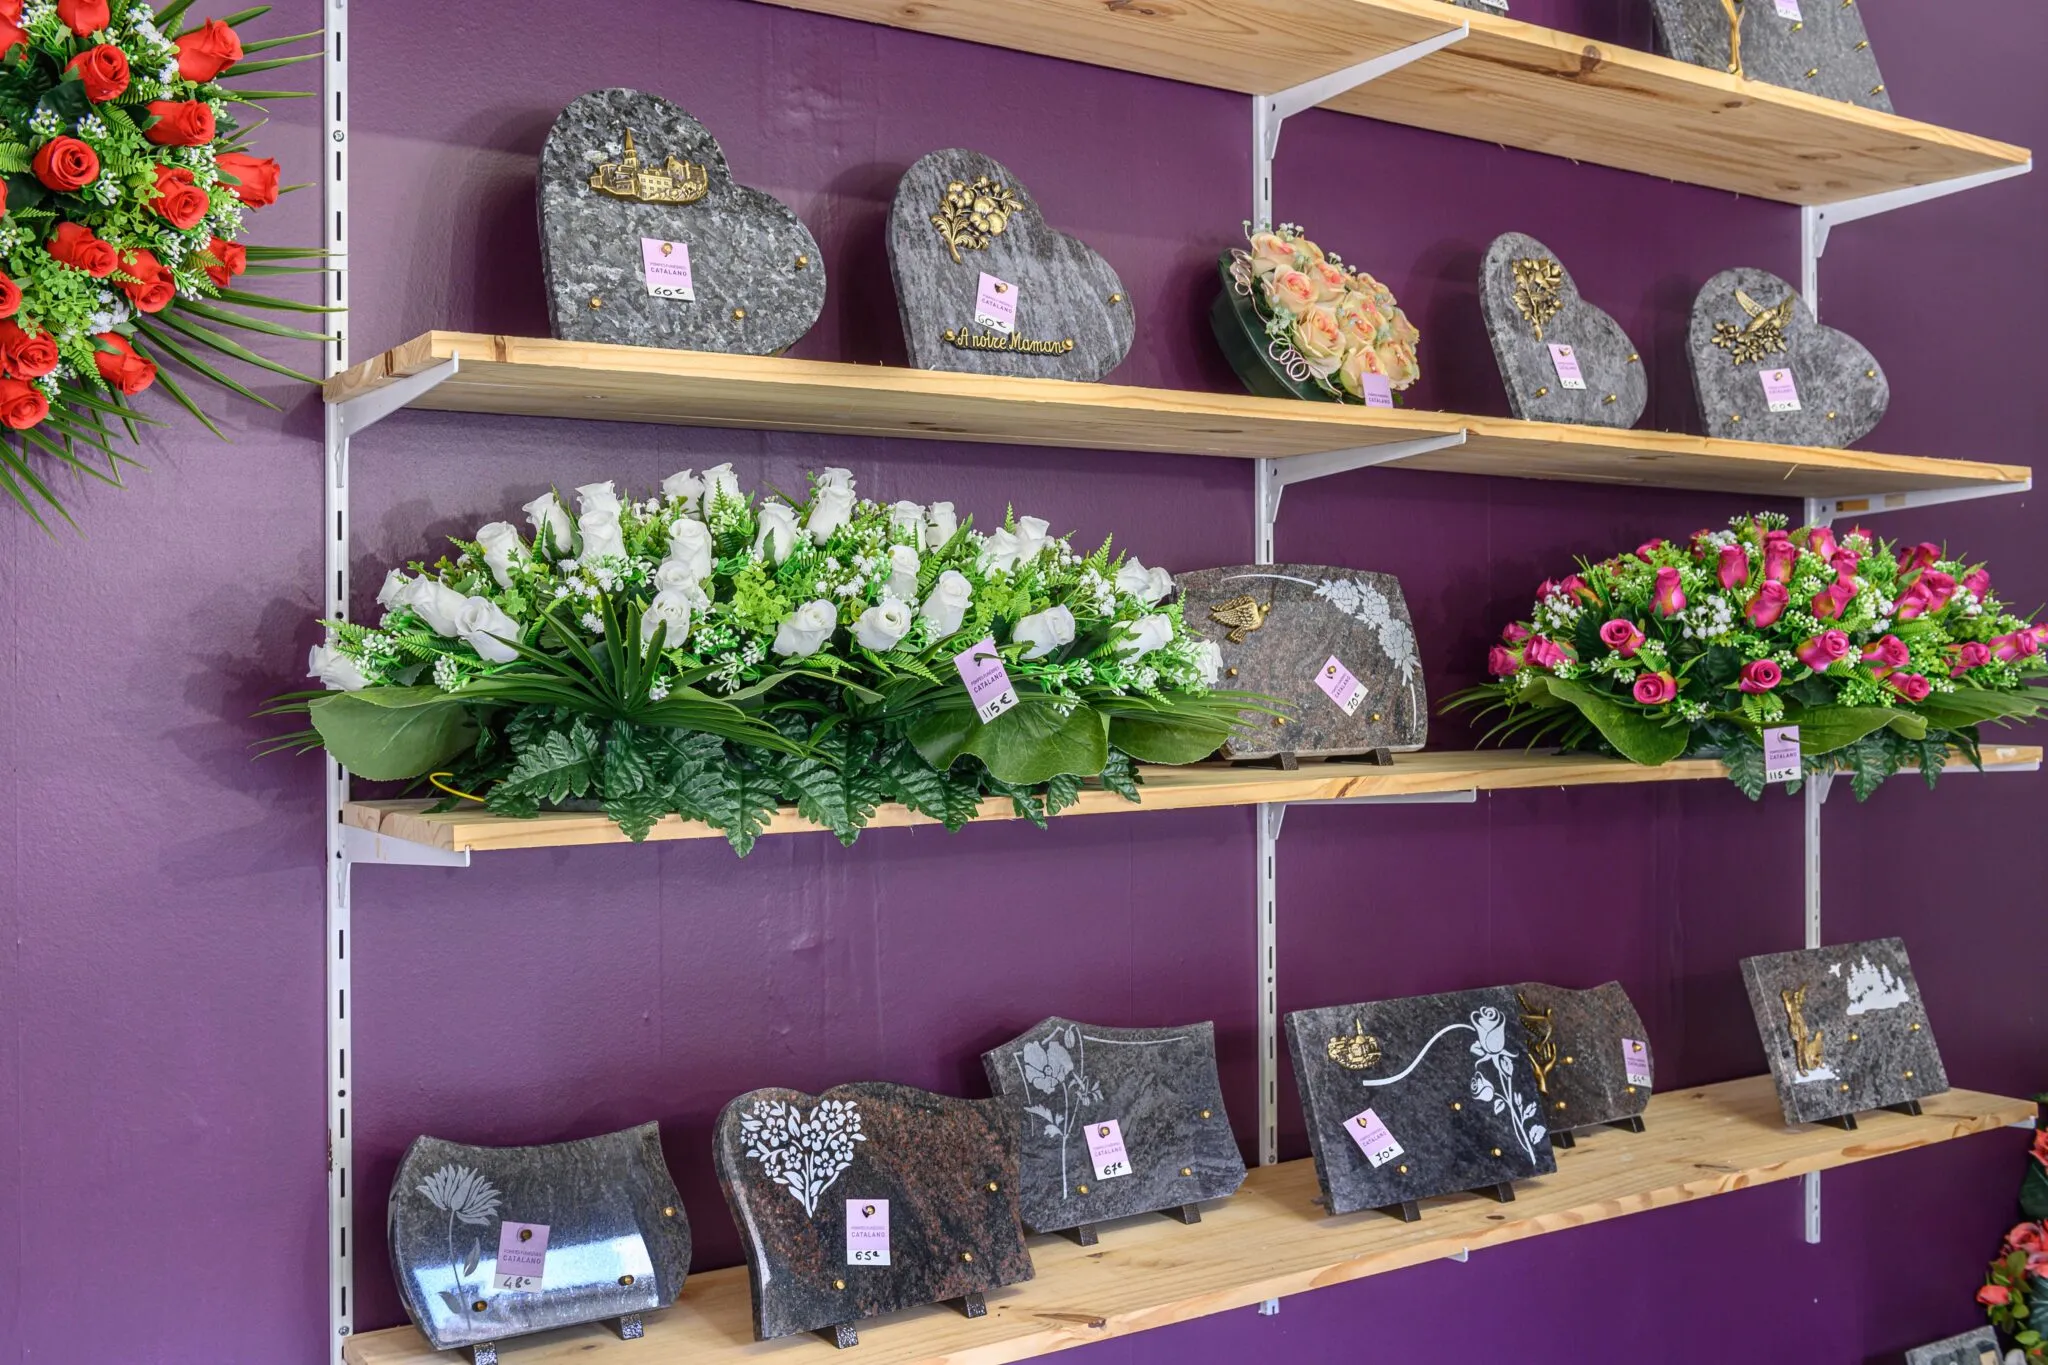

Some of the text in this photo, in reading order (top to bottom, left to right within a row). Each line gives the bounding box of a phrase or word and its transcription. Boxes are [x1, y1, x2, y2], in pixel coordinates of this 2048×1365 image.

[651, 267, 687, 277] CATALANO
[982, 298, 1012, 313] CATALANO
[957, 326, 1063, 353] A notre Maman
[973, 671, 1003, 693] CATALANO
[1334, 675, 1351, 698] CATALANO
[1770, 752, 1797, 760] CATALANO
[1362, 1130, 1387, 1147] CATALANO
[1095, 1146, 1122, 1157] CATALANO
[503, 1254, 541, 1264] CATALANO
